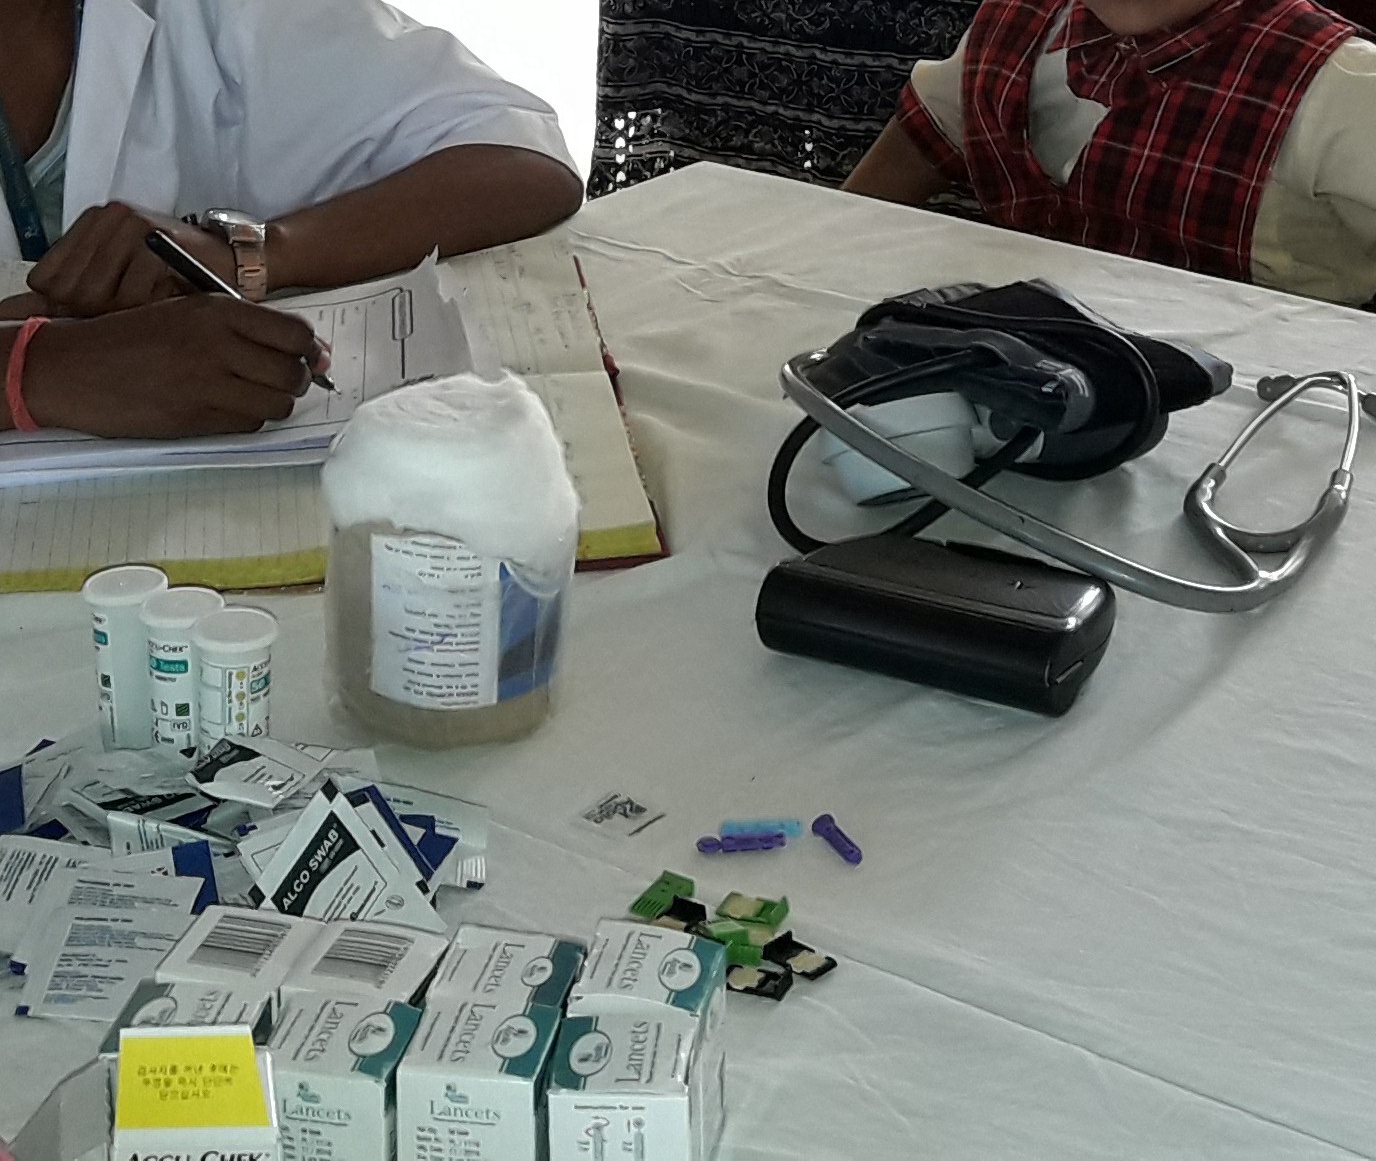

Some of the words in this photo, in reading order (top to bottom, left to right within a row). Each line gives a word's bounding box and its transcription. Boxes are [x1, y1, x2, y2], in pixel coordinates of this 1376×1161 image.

[282, 869, 311, 911] ALCO
[308, 828, 340, 872] SWAB
[482, 942, 526, 995] Lancets
[619, 932, 663, 991] Lancets
[303, 1000, 360, 1062] Lancets
[449, 1002, 497, 1064] Lancets
[615, 1020, 651, 1084] Lancets
[283, 1098, 353, 1122] Lancets
[429, 1099, 503, 1122] Lancets
